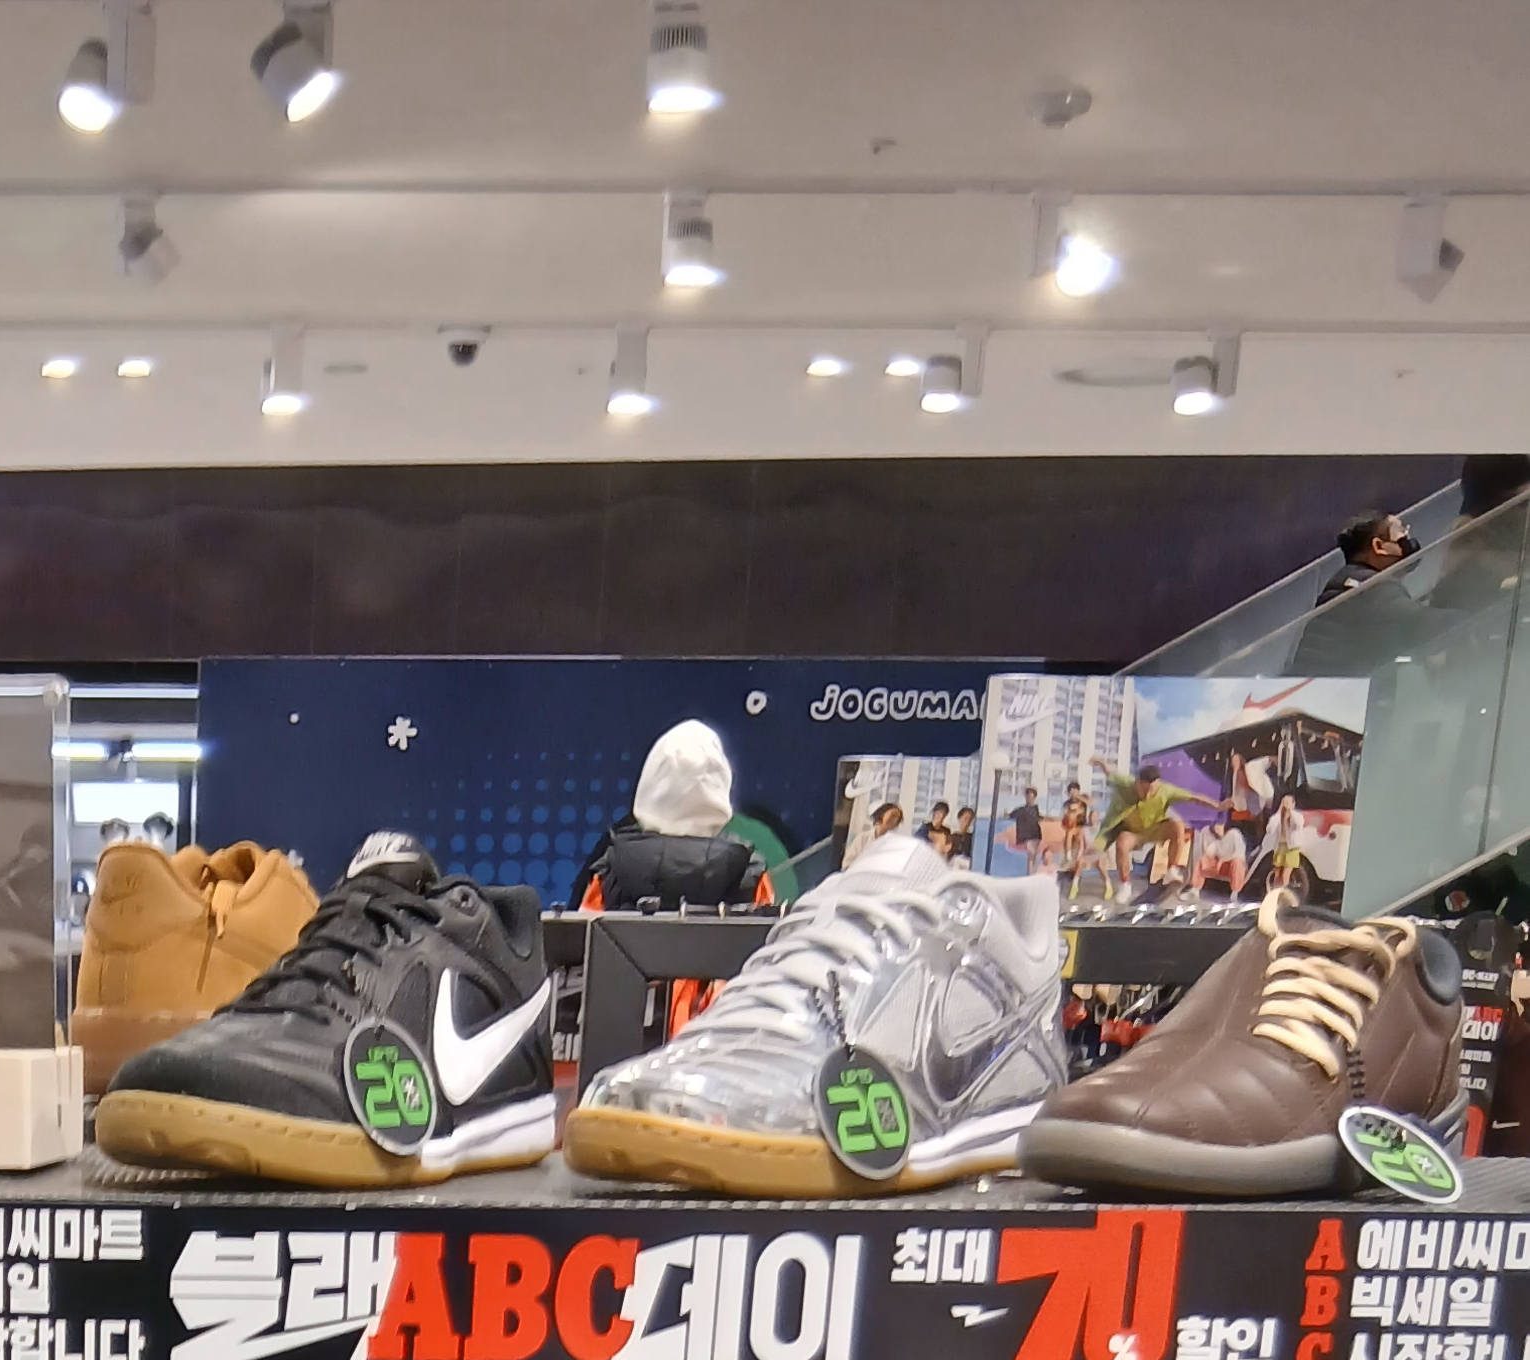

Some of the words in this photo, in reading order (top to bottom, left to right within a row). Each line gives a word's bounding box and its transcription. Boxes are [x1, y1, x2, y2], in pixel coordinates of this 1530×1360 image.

[809, 683, 986, 721] JOGUMA
[890, 1227, 994, 1284] 최대
[1305, 1218, 1346, 1272] A
[1300, 1276, 1340, 1327] B
[1349, 1275, 1498, 1328] 빅세일
